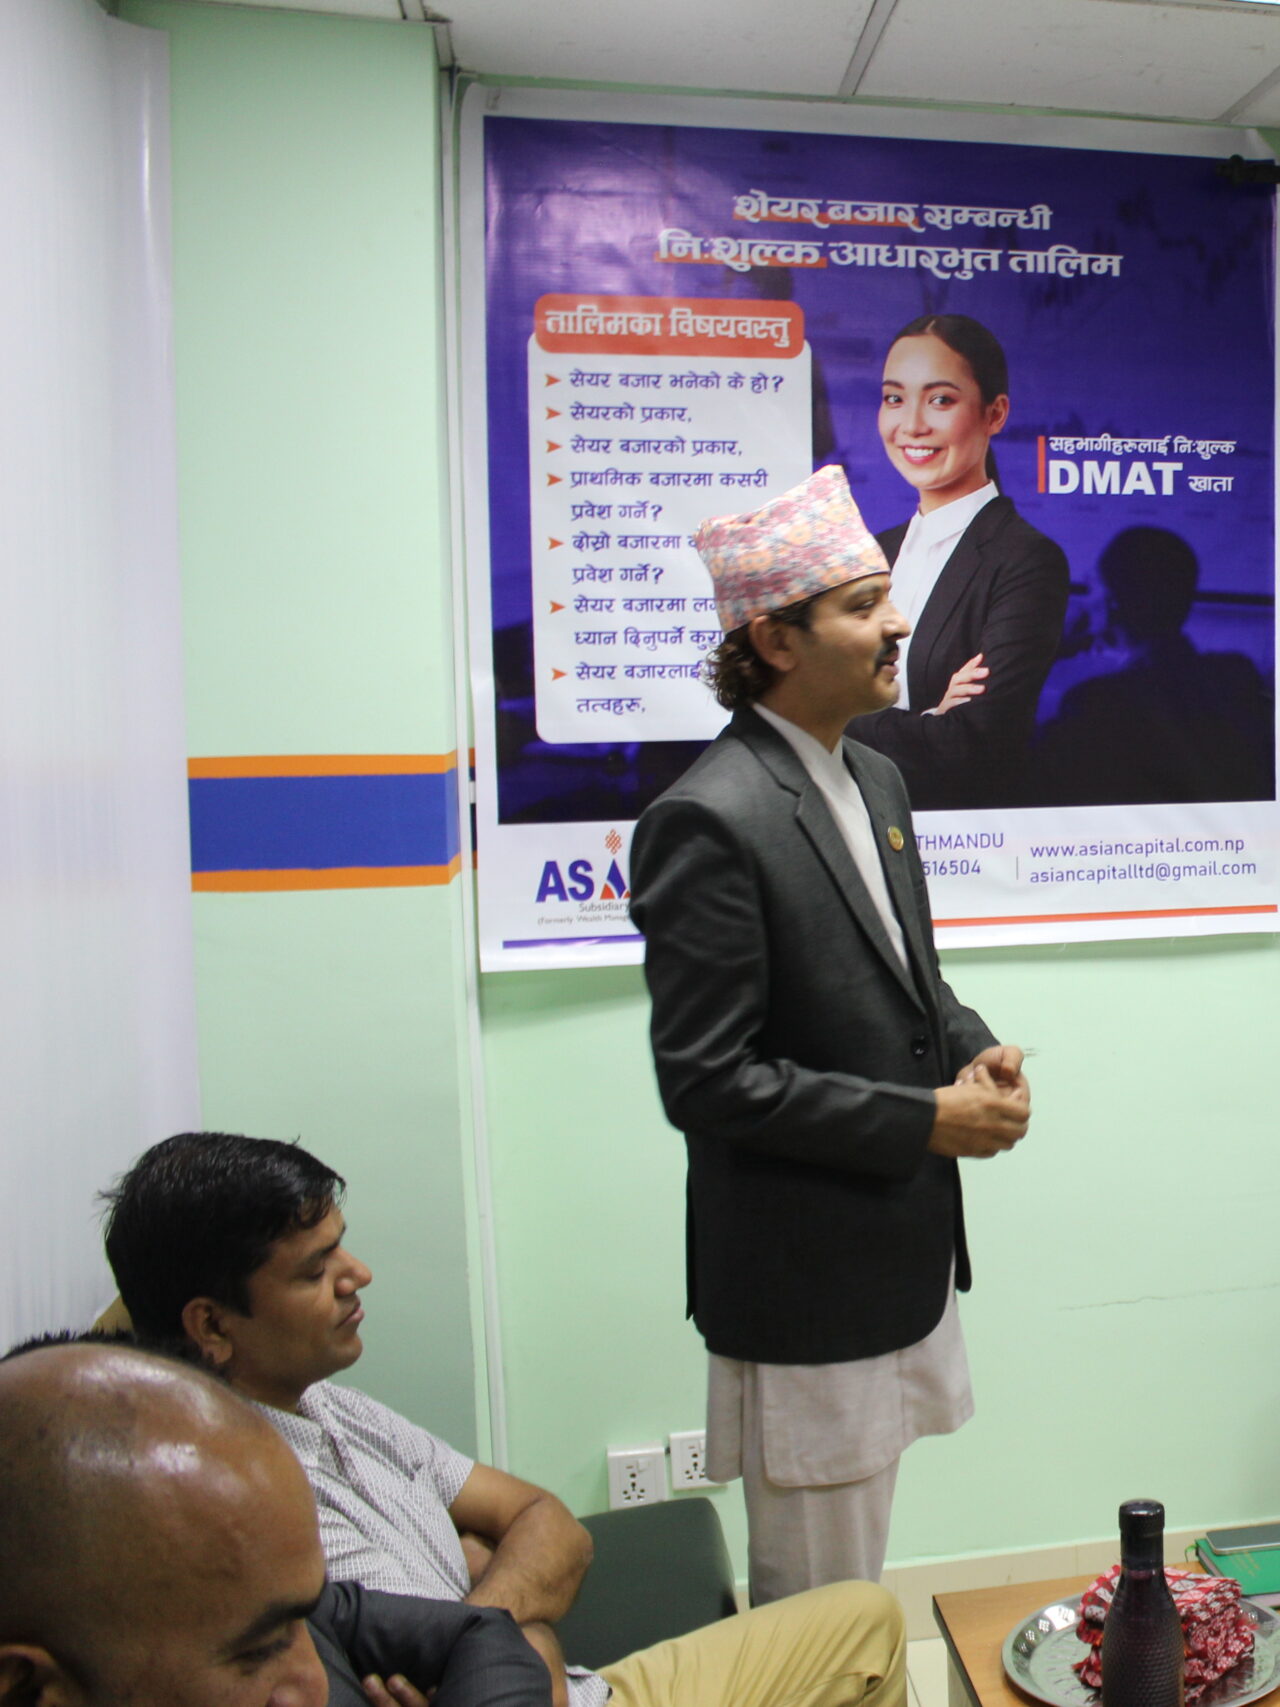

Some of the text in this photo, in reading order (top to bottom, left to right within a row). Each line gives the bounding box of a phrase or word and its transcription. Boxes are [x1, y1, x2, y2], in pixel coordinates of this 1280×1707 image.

[734, 189, 1053, 233] शेयर बजार सम्बन्धी
[829, 242, 1001, 279] आधारभुत
[1008, 245, 1124, 278] तालिम
[545, 304, 792, 347] तालिमका विषयवस्तु
[569, 369, 611, 388] सेयर
[619, 374, 662, 389] बजार
[669, 370, 721, 389] भनेको
[727, 371, 744, 389] के
[570, 401, 634, 420] सेयरको
[571, 435, 612, 454] सेयर
[620, 436, 686, 454] बजारको
[570, 468, 768, 488] प्राथमिक बजारमा कसरी
[1048, 459, 1235, 495] DMAT खाता
[571, 501, 612, 521] प्रवेश
[618, 535, 681, 549] बजारमा
[573, 564, 612, 585] प्रवेश
[573, 594, 616, 613] सेयर
[622, 598, 686, 612] बजारमा
[575, 630, 618, 645] ध्यान
[624, 626, 686, 651] दिनुपर्ने
[576, 662, 617, 680] सेयर
[624, 660, 702, 681] बजारलाई
[1030, 837, 1245, 859] www.asiancapital.com.np
[922, 859, 981, 876] 516504
[1030, 861, 1257, 884] asiancapitalltd@gmail.com
